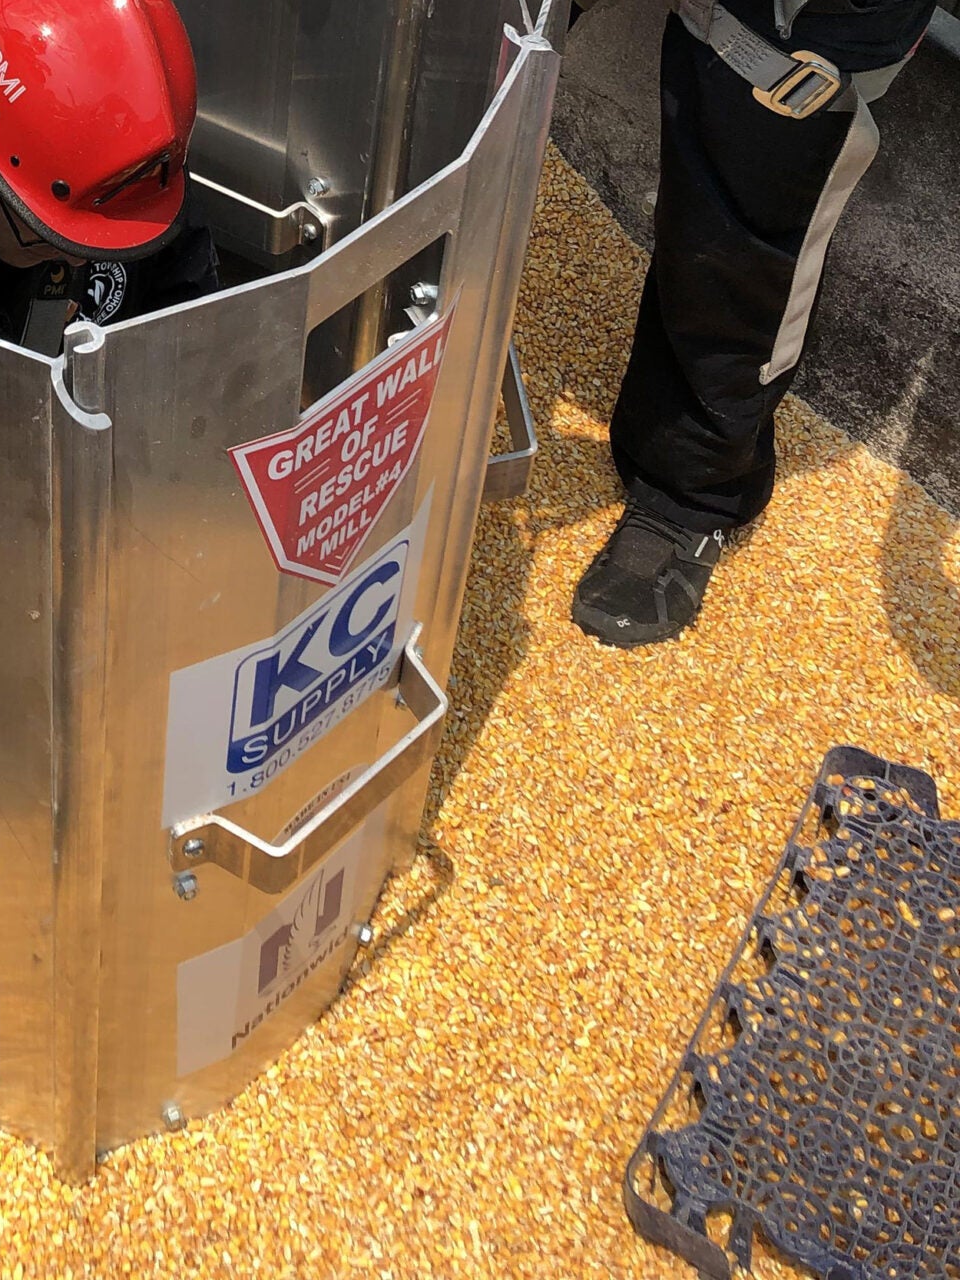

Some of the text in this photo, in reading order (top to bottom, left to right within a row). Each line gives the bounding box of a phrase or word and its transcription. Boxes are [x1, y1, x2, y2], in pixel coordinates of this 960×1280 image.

[43, 283, 66, 296] PMI
[105, 290, 123, 312] OHIO
[267, 393, 369, 481] GREAT
[298, 420, 409, 526] RESCUE
[340, 415, 378, 463] OF
[296, 459, 402, 557] MODEL#4
[319, 509, 372, 561] MILL
[250, 560, 400, 728] KC
[226, 665, 391, 797] 1.800.527.8775
[241, 631, 389, 765] SUPPLY
